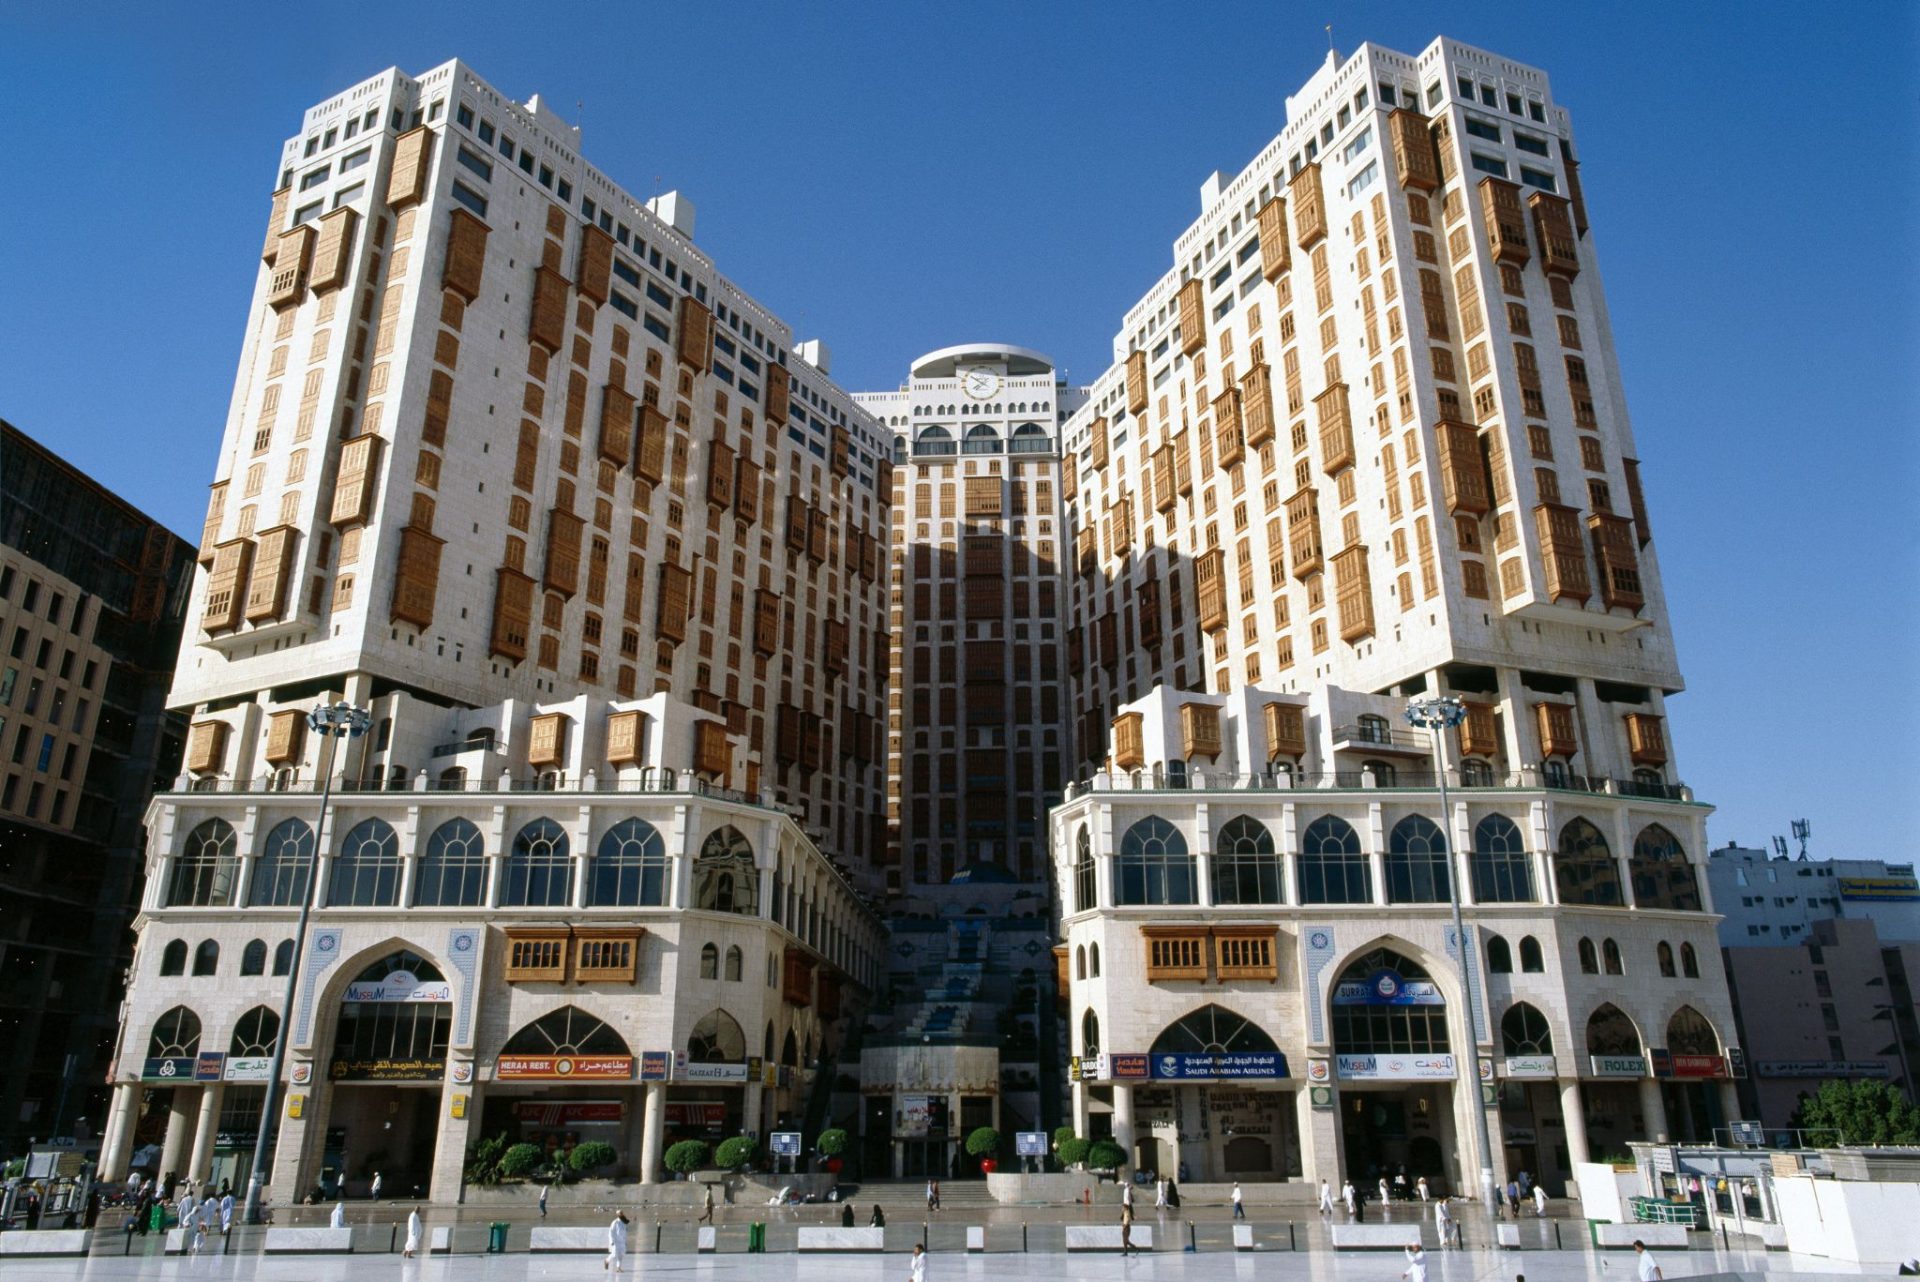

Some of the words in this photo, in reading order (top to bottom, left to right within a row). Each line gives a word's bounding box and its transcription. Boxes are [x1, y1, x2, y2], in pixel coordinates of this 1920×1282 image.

[501, 1061, 527, 1069] HERAA
[529, 1061, 551, 1069] REST.
[579, 1060, 602, 1072] حراء
[601, 1060, 628, 1072] مطاعم
[1185, 1057, 1213, 1066] السعودية
[1604, 1060, 1644, 1072] ROLEX
[565, 1106, 584, 1117] KFC
